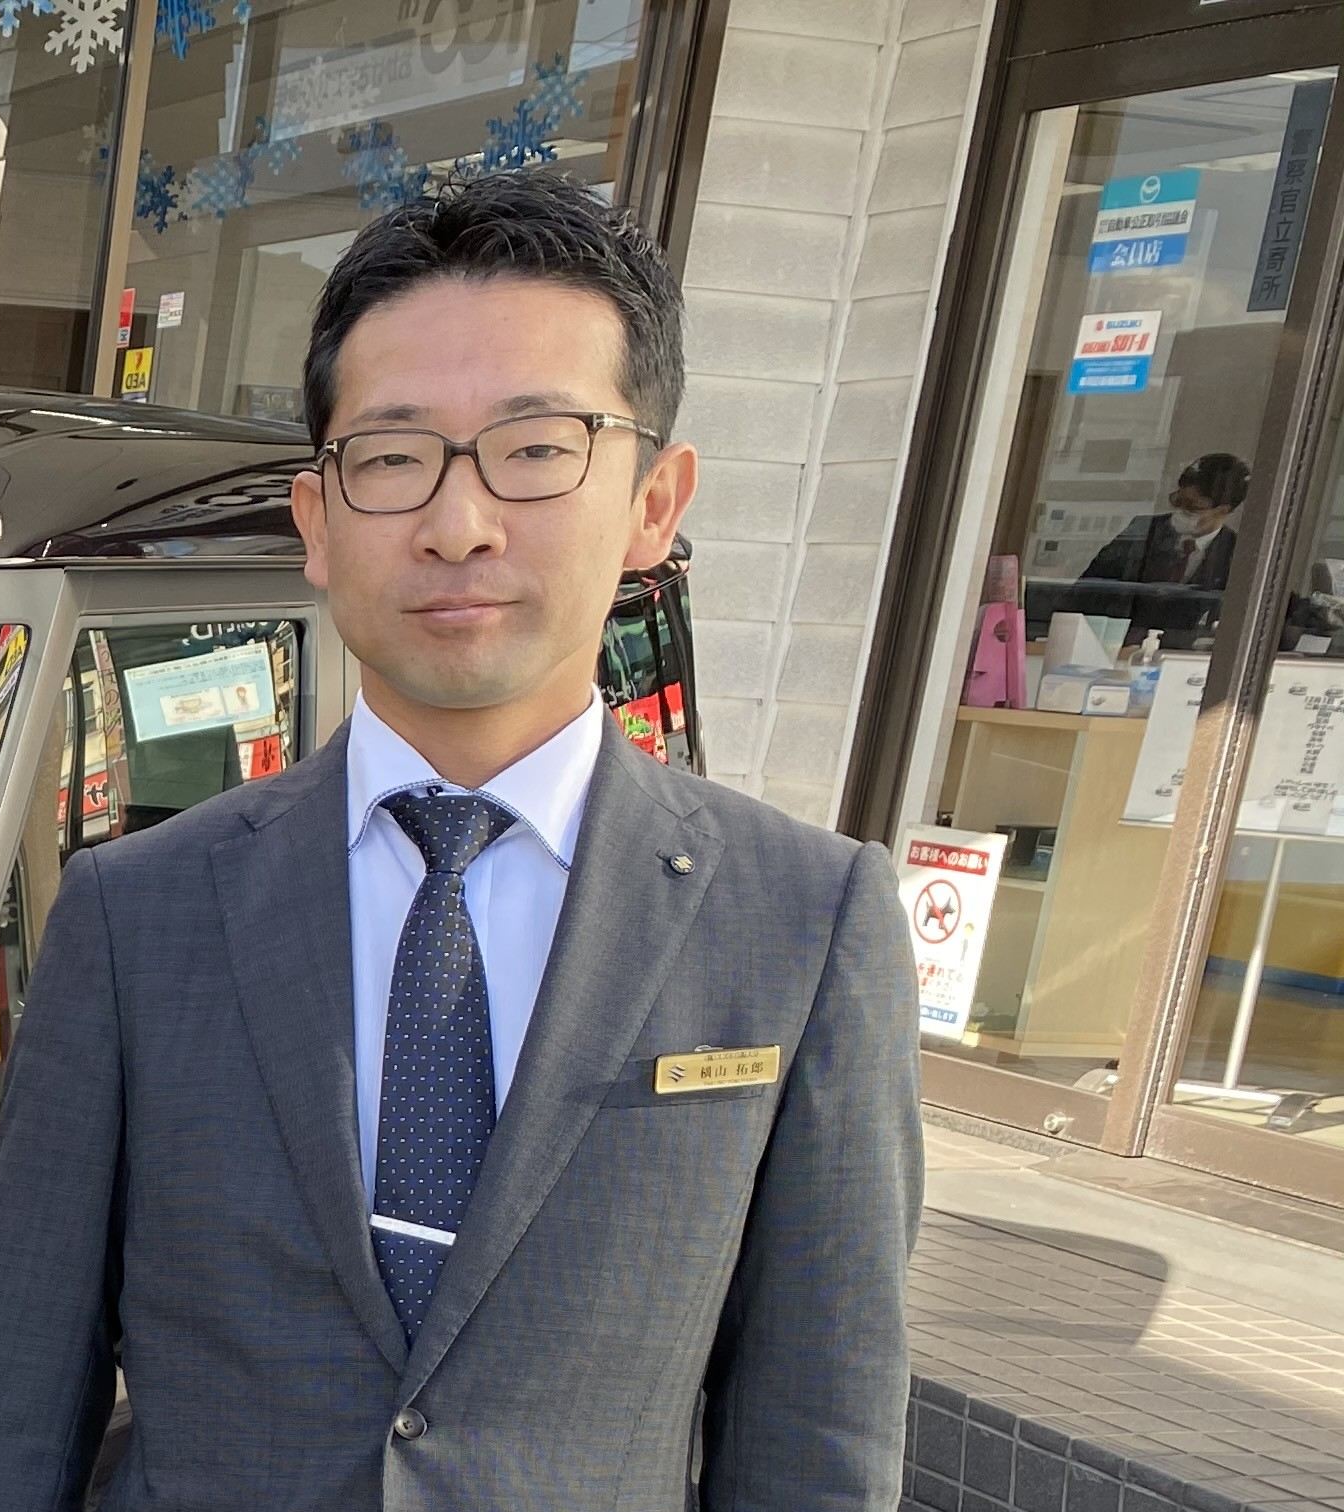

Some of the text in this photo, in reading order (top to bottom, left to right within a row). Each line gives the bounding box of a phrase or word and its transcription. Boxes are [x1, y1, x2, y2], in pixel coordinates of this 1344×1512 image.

[910, 846, 988, 871] お客様へのお願い
